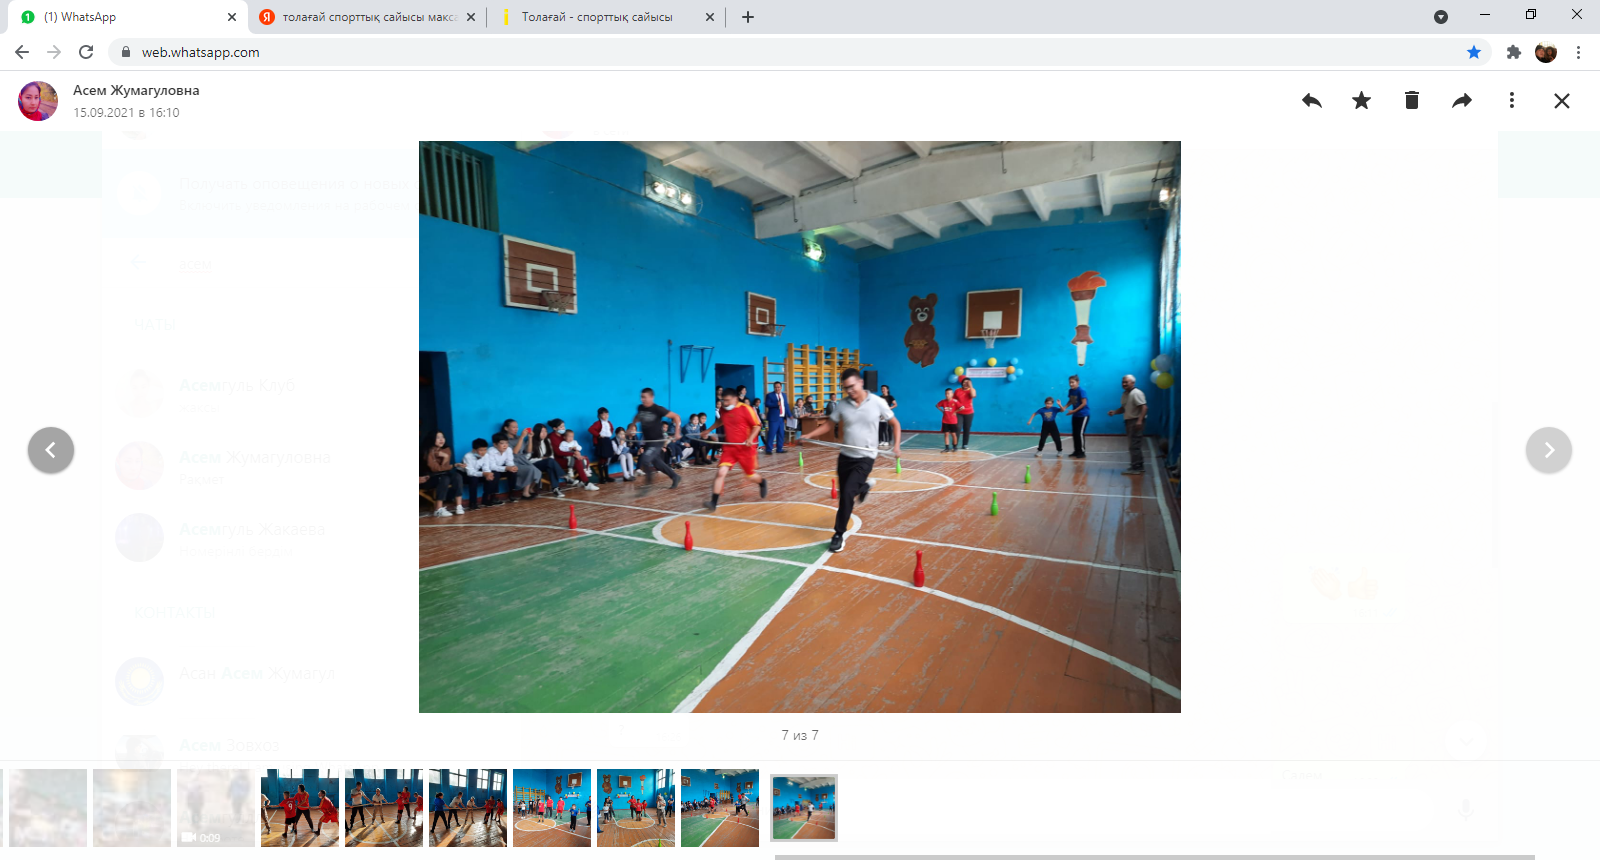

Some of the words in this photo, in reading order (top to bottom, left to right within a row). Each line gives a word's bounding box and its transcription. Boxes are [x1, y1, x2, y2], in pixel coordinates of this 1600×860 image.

[44, 11, 58, 25] (1)
[61, 11, 117, 25] WhatsApp
[283, 11, 326, 22] толағай
[328, 14, 381, 25] спорттық
[383, 11, 425, 22] сайысы
[521, 11, 566, 22] Толағай
[576, 14, 629, 25] спорттық
[631, 11, 673, 22] сайысы
[141, 46, 260, 61] web.whatsapp.com
[73, 84, 107, 97] Асем
[110, 84, 200, 100] Жумагуловна
[74, 107, 134, 118] 15.09.2021
[138, 109, 146, 118] в
[149, 107, 180, 118] 16:10
[179, 177, 248, 194] Получать
[252, 180, 345, 192] оповещения
[364, 180, 410, 190] новых
[179, 199, 242, 211] Включить
[245, 202, 330, 214] уведомления
[354, 199, 410, 214] рабочем
[179, 260, 212, 271] асем
[134, 318, 176, 331] ЧАТЫ
[179, 378, 254, 396] Асемгуль
[259, 377, 296, 396] Клуб
[179, 450, 222, 464] Асем
[226, 450, 331, 468] Жумагуловна
[179, 522, 254, 540] Асемгуль
[258, 522, 326, 536] Жакаева
[134, 606, 216, 619] КОНТАКТЫ
[179, 666, 216, 680] Асан
[221, 666, 264, 680] Асем
[267, 666, 335, 684] Жумагул
[781, 729, 790, 741] 7
[792, 732, 808, 741] из
[811, 729, 820, 741] 7
[179, 738, 222, 752] Асем
[226, 738, 280, 752] Зовхоз
[199, 833, 221, 843] 0:09
